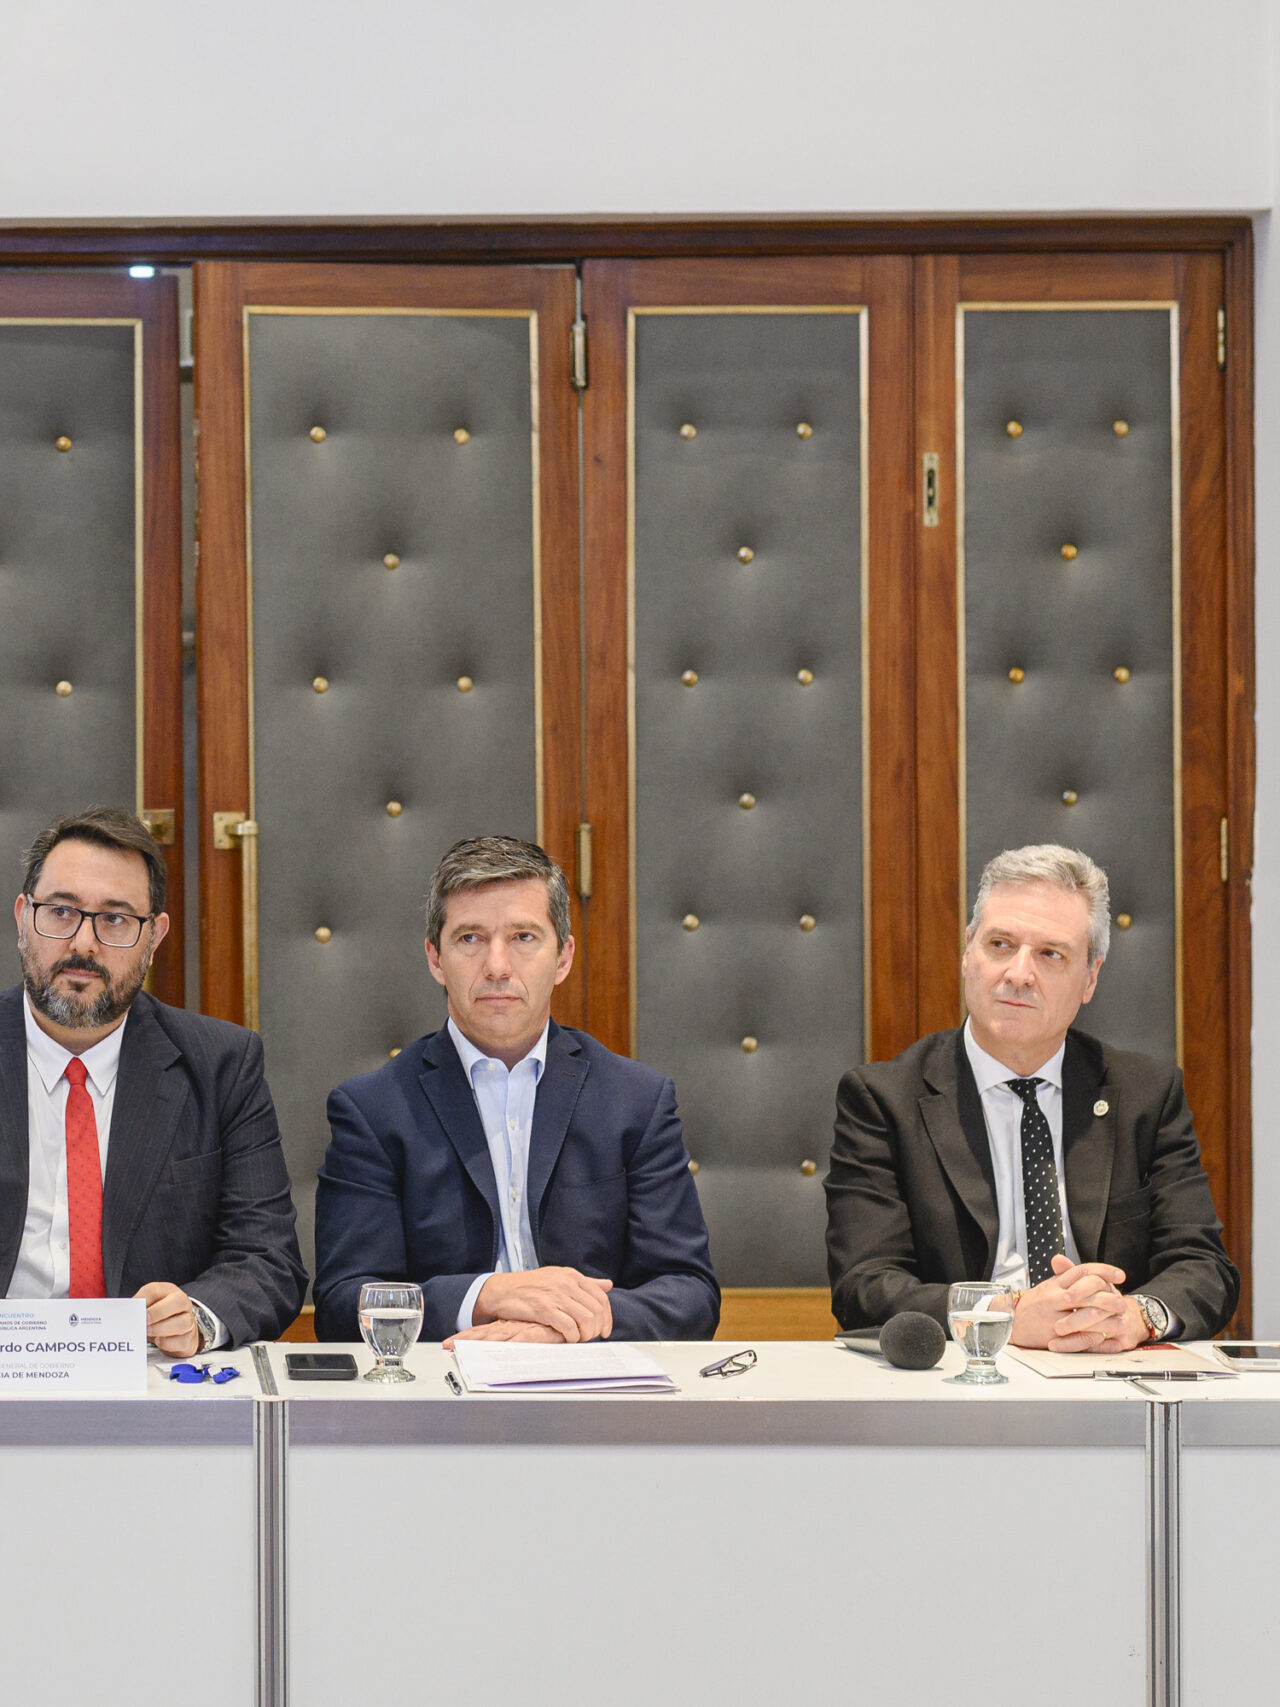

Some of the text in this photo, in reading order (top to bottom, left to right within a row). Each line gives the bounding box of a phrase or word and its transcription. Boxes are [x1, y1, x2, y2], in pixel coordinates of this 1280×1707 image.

[25, 1342, 86, 1353] CAMPOS
[89, 1341, 134, 1352] FADEL
[12, 1371, 24, 1379] DE
[26, 1371, 70, 1379] MENDOZA
